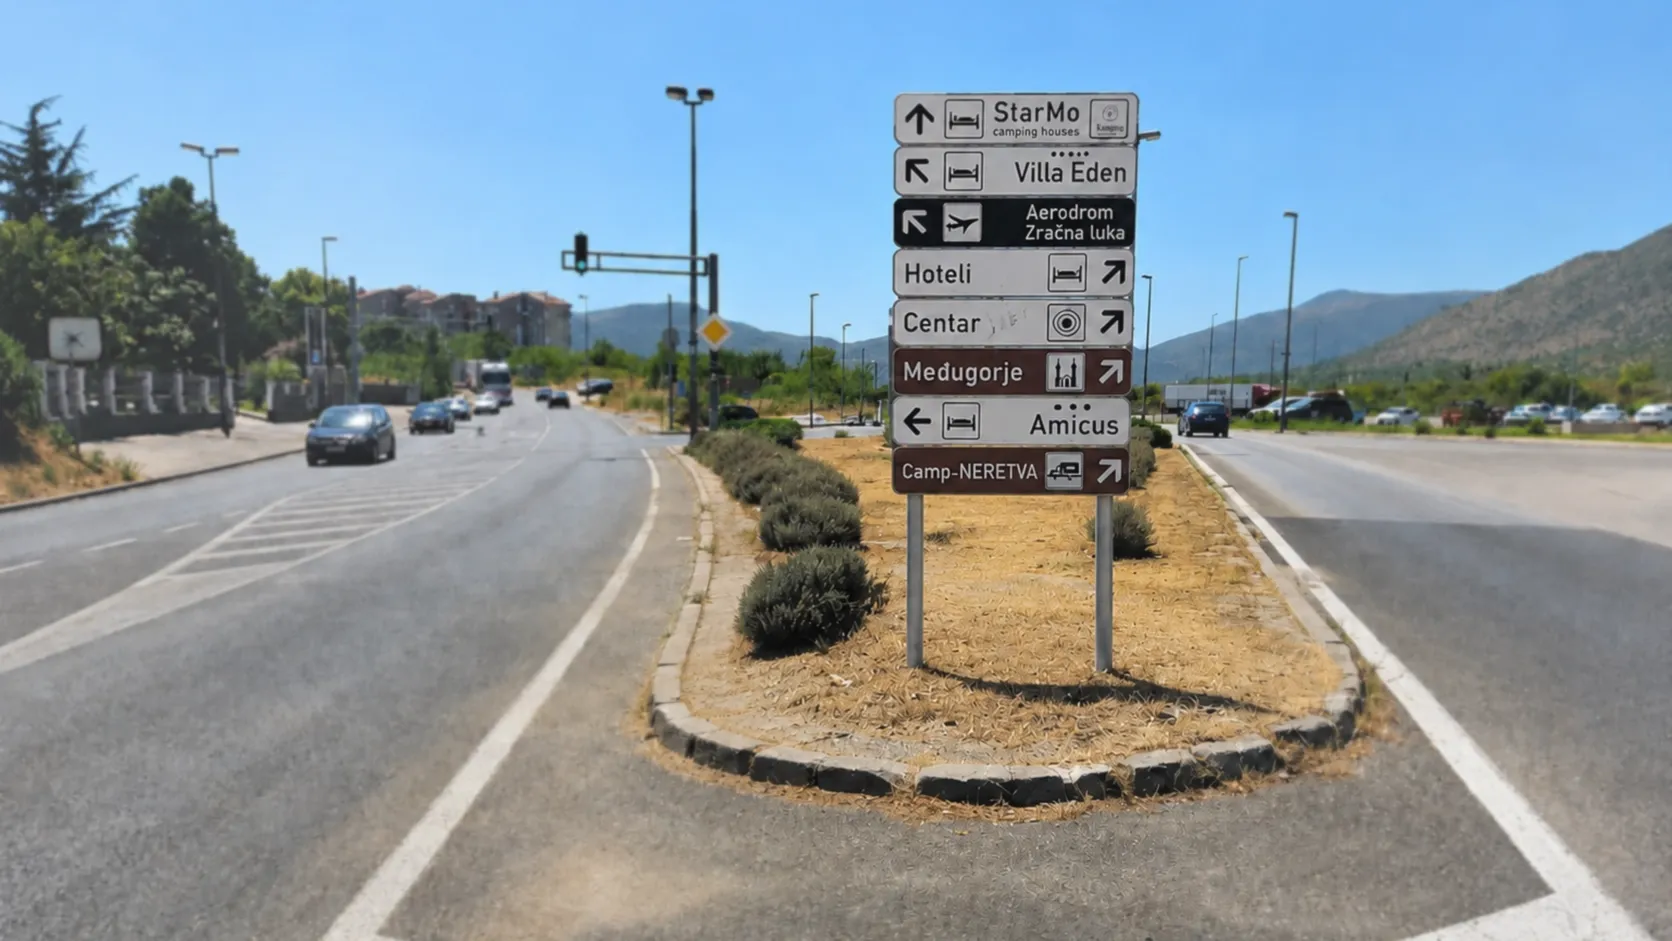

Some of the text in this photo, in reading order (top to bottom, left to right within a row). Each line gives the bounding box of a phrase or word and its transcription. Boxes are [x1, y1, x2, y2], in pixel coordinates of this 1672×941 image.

[994, 101, 1080, 122] StarMo
[993, 126, 1080, 138] camping houses
[1015, 161, 1126, 183] Villa Eden
[1026, 204, 1114, 220] Aerodrom
[1025, 224, 1125, 240] Zračna luka
[905, 263, 971, 284] Hoteli
[904, 312, 981, 333] Centar
[904, 361, 1023, 387] Međugorje
[1030, 414, 1119, 435] Amicus
[902, 463, 1038, 483] Camp-NERETVA
